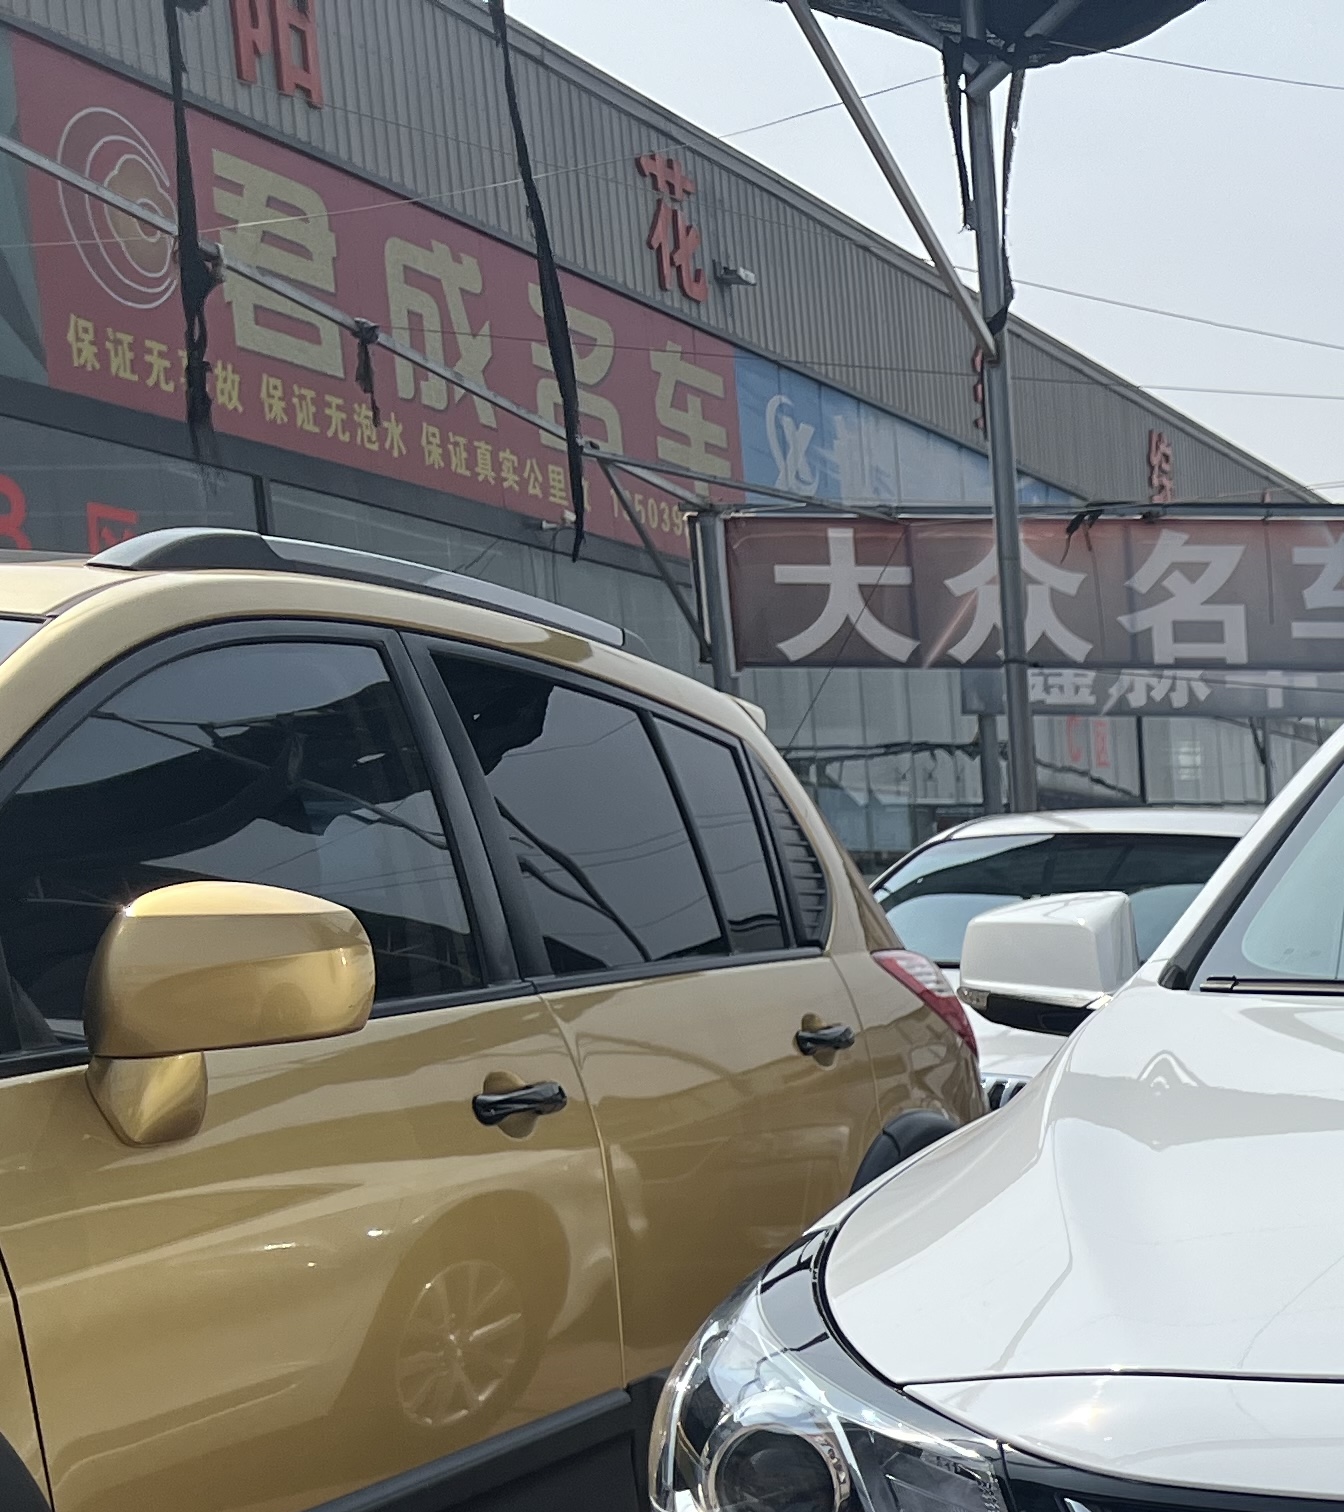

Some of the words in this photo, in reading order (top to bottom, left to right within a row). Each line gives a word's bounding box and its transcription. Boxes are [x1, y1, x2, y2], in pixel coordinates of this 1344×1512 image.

[230, 0, 324, 110] 阳
[635, 153, 709, 304] 花
[66, 313, 244, 413] 保证无故
[420, 421, 592, 514] 保证真实公里
[211, 148, 734, 500] 君成名车
